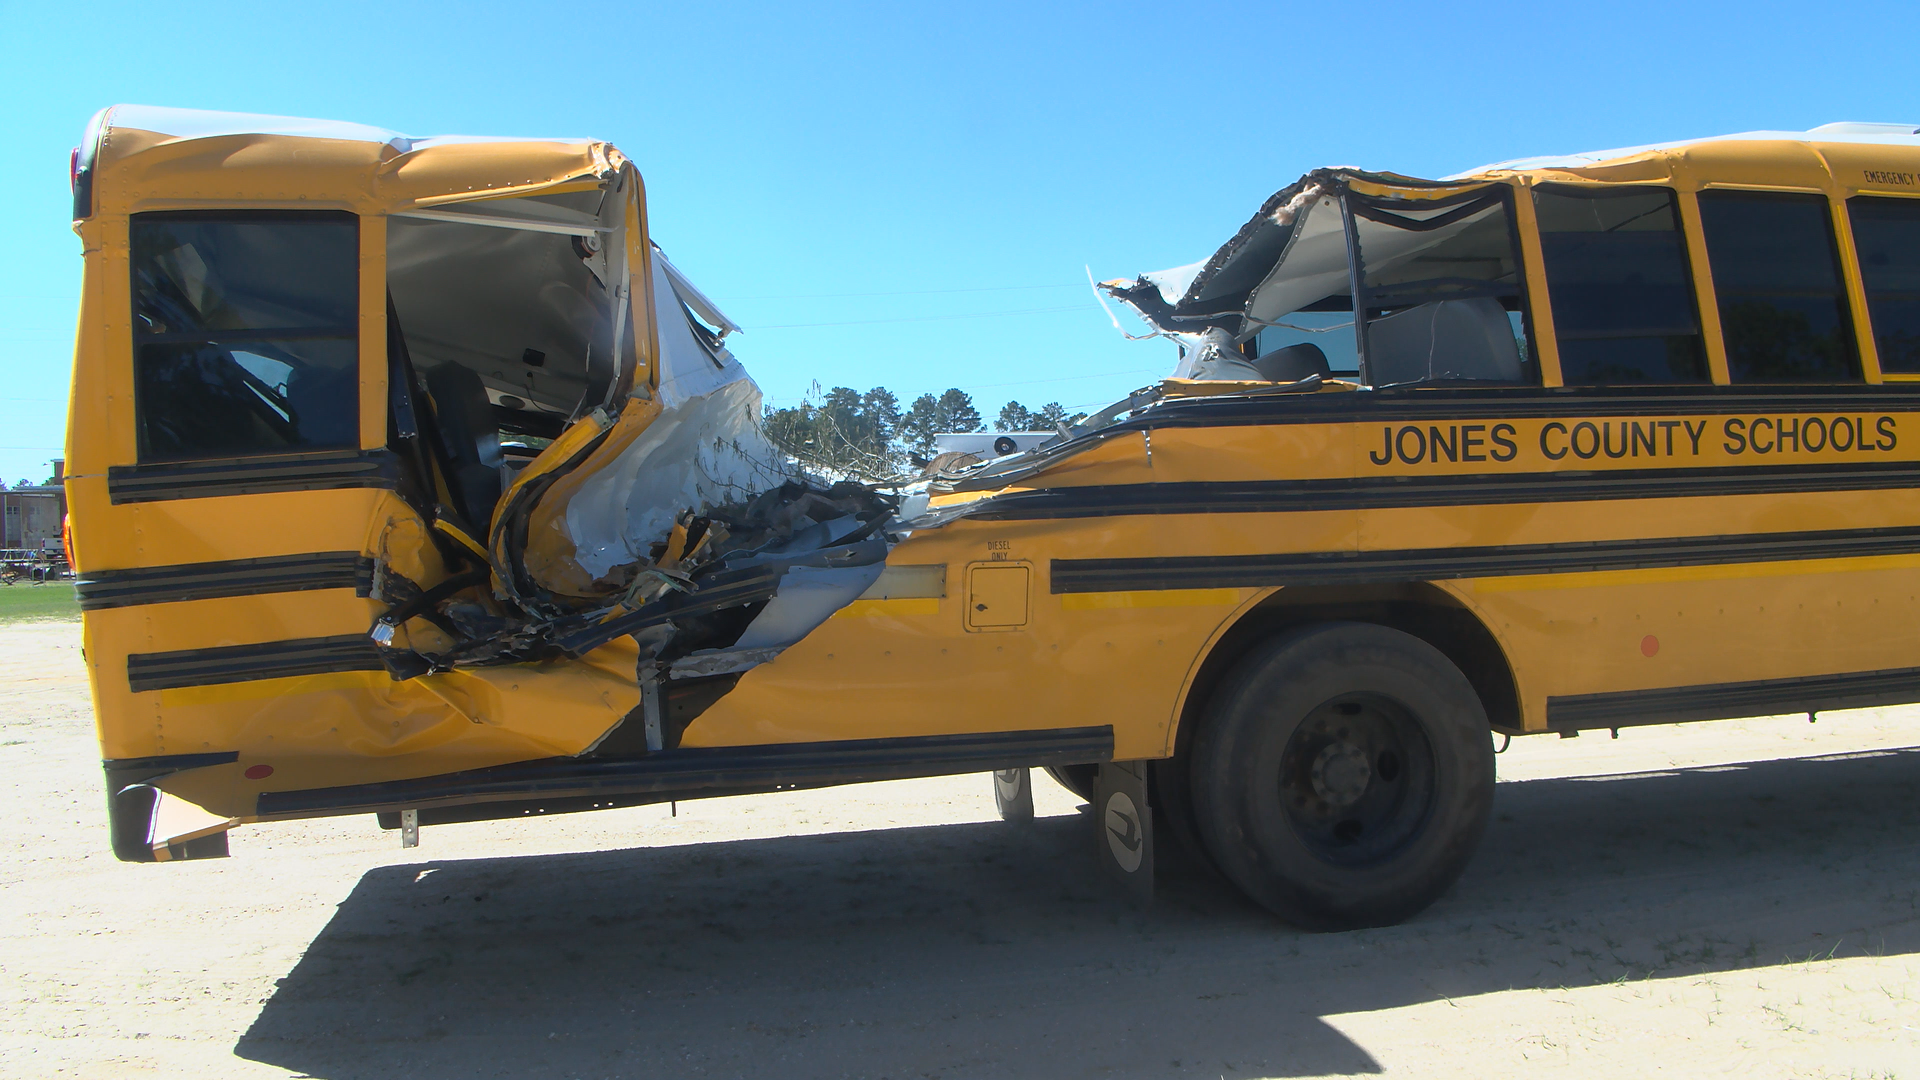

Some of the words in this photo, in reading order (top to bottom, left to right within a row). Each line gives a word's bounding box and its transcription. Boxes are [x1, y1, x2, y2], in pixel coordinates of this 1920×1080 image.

[1863, 170, 1915, 185] EMERGENCY
[1369, 423, 1518, 466] JONES
[1539, 420, 1707, 461] COUNTY
[1722, 416, 1897, 456] SCHOOLS
[987, 541, 1011, 551] DIESEL
[991, 552, 1008, 562] ONLY
